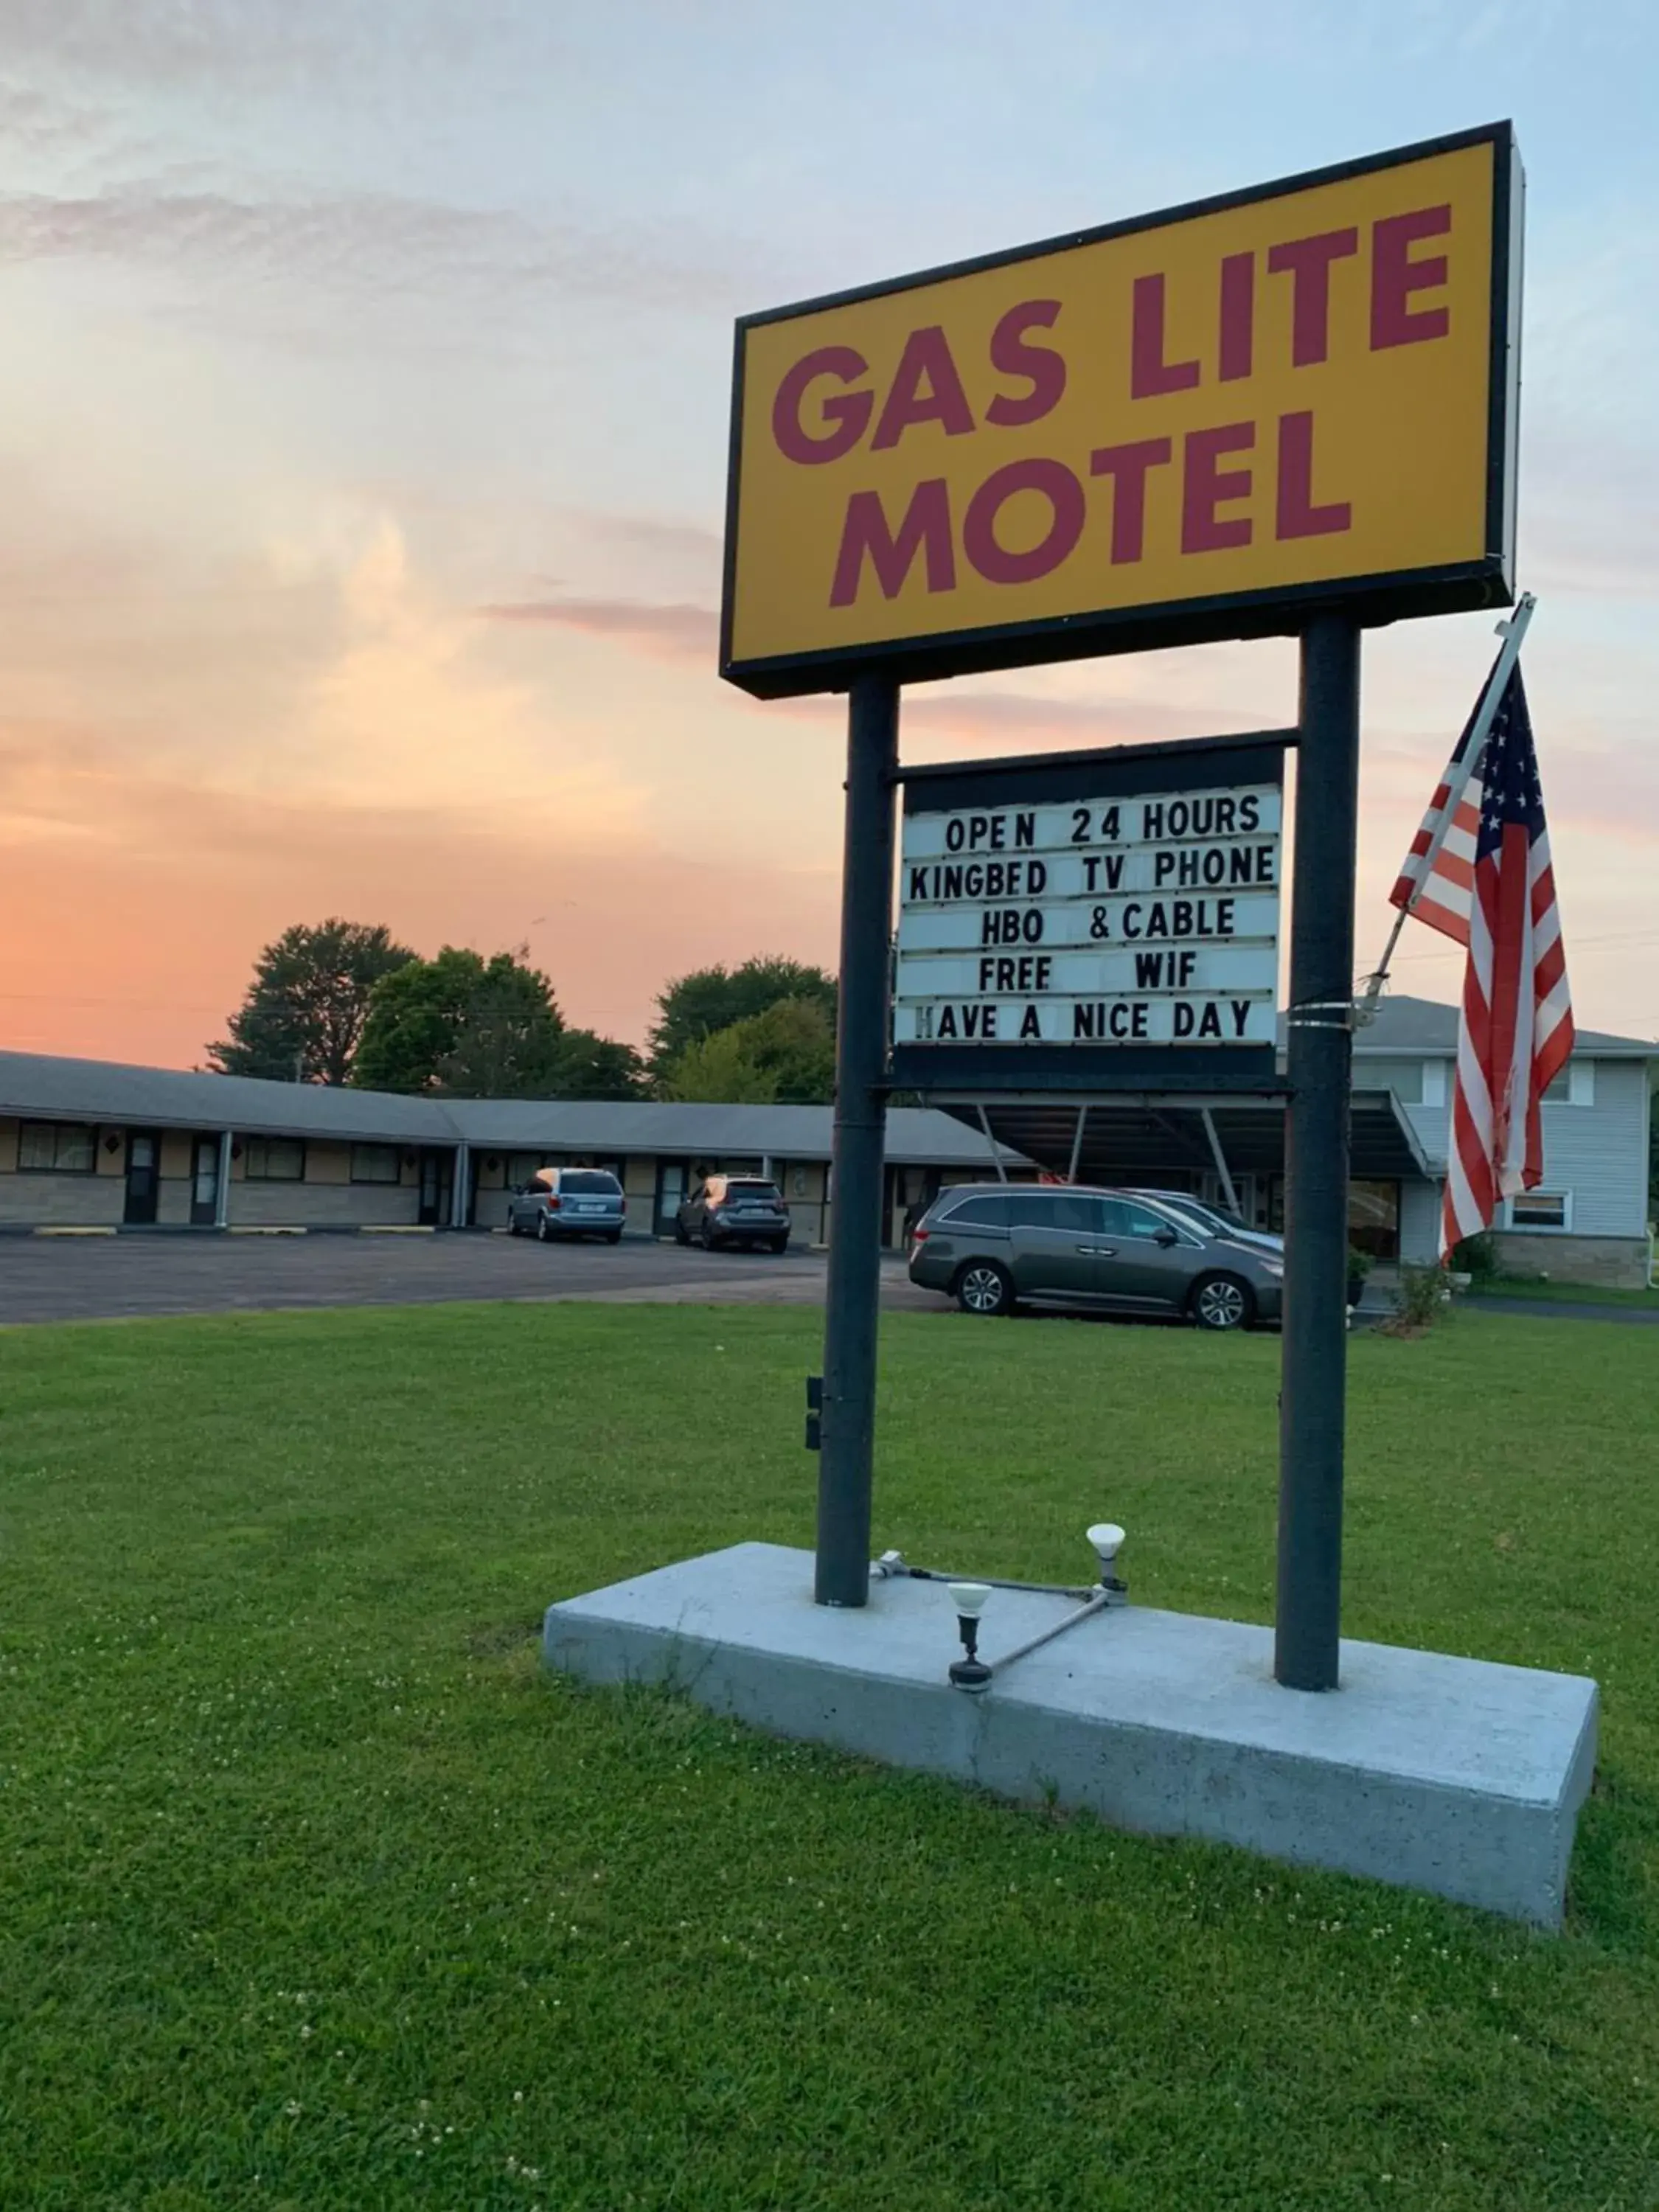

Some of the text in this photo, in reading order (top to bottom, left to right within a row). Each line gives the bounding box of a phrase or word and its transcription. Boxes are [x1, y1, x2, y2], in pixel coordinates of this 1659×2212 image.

[772, 204, 1453, 466] GAS LITE
[829, 409, 1352, 608] MOTEL
[946, 796, 1259, 852] OPEN 24 HOURS
[910, 846, 1274, 900] KINGBED TV PHONE
[981, 900, 1234, 944] HBO & CABLE
[979, 952, 1197, 990] FREE WIF
[915, 1001, 1251, 1039] HAVE A NICE DAY
